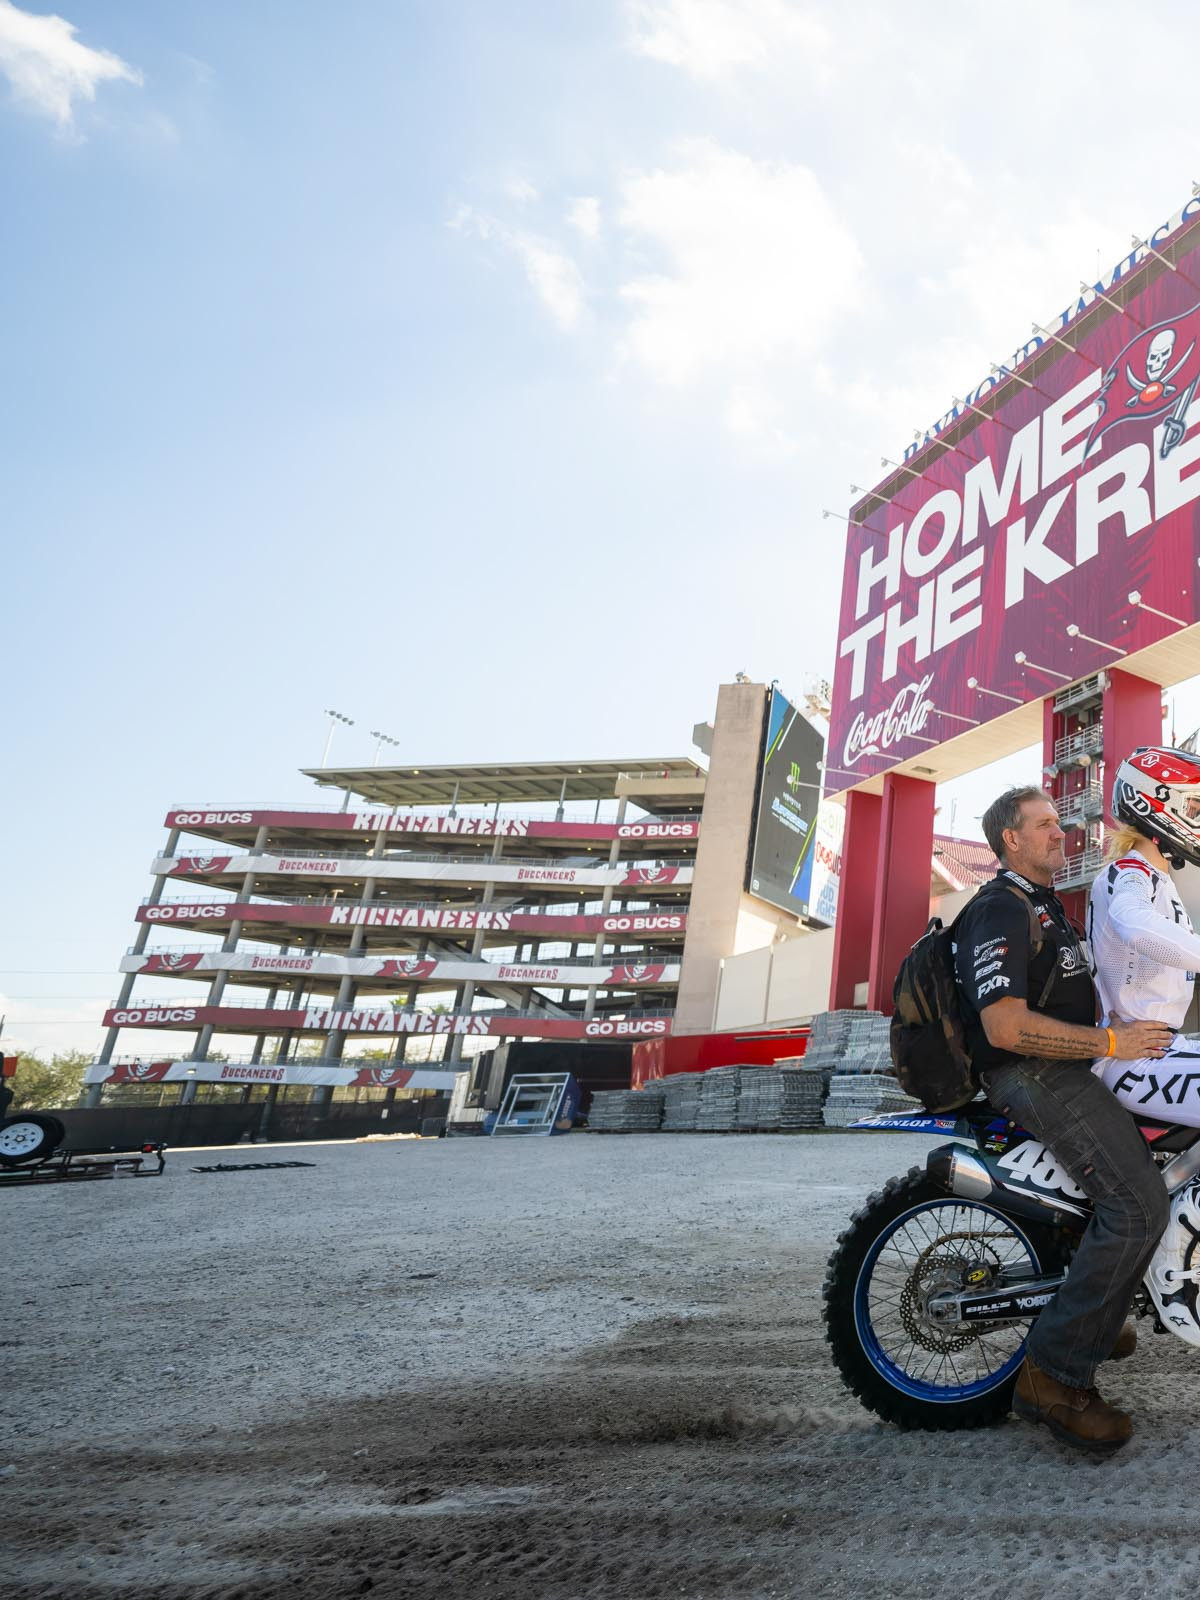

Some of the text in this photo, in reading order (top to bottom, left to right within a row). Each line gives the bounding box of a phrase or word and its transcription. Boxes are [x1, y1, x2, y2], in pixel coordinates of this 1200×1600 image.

[856, 368, 1102, 621] HOME
[840, 545, 984, 701] THE
[174, 812, 253, 825] GO BUCS
[618, 824, 693, 837] GO BUCS
[278, 859, 338, 873] BUCCANEERS
[517, 868, 576, 882] BUCCANEERS
[145, 905, 226, 919] GO BUCS
[604, 916, 681, 930] GO BUCS
[252, 956, 313, 970] BUCCANEERS
[498, 966, 558, 980] BUCCANEERS
[977, 975, 1011, 1000] FXR
[113, 1009, 196, 1024] GO BUCS
[586, 1020, 665, 1035] GO BUCS
[221, 1066, 285, 1080] BUCCANEERS
[871, 1119, 931, 1128] DUNLOP
